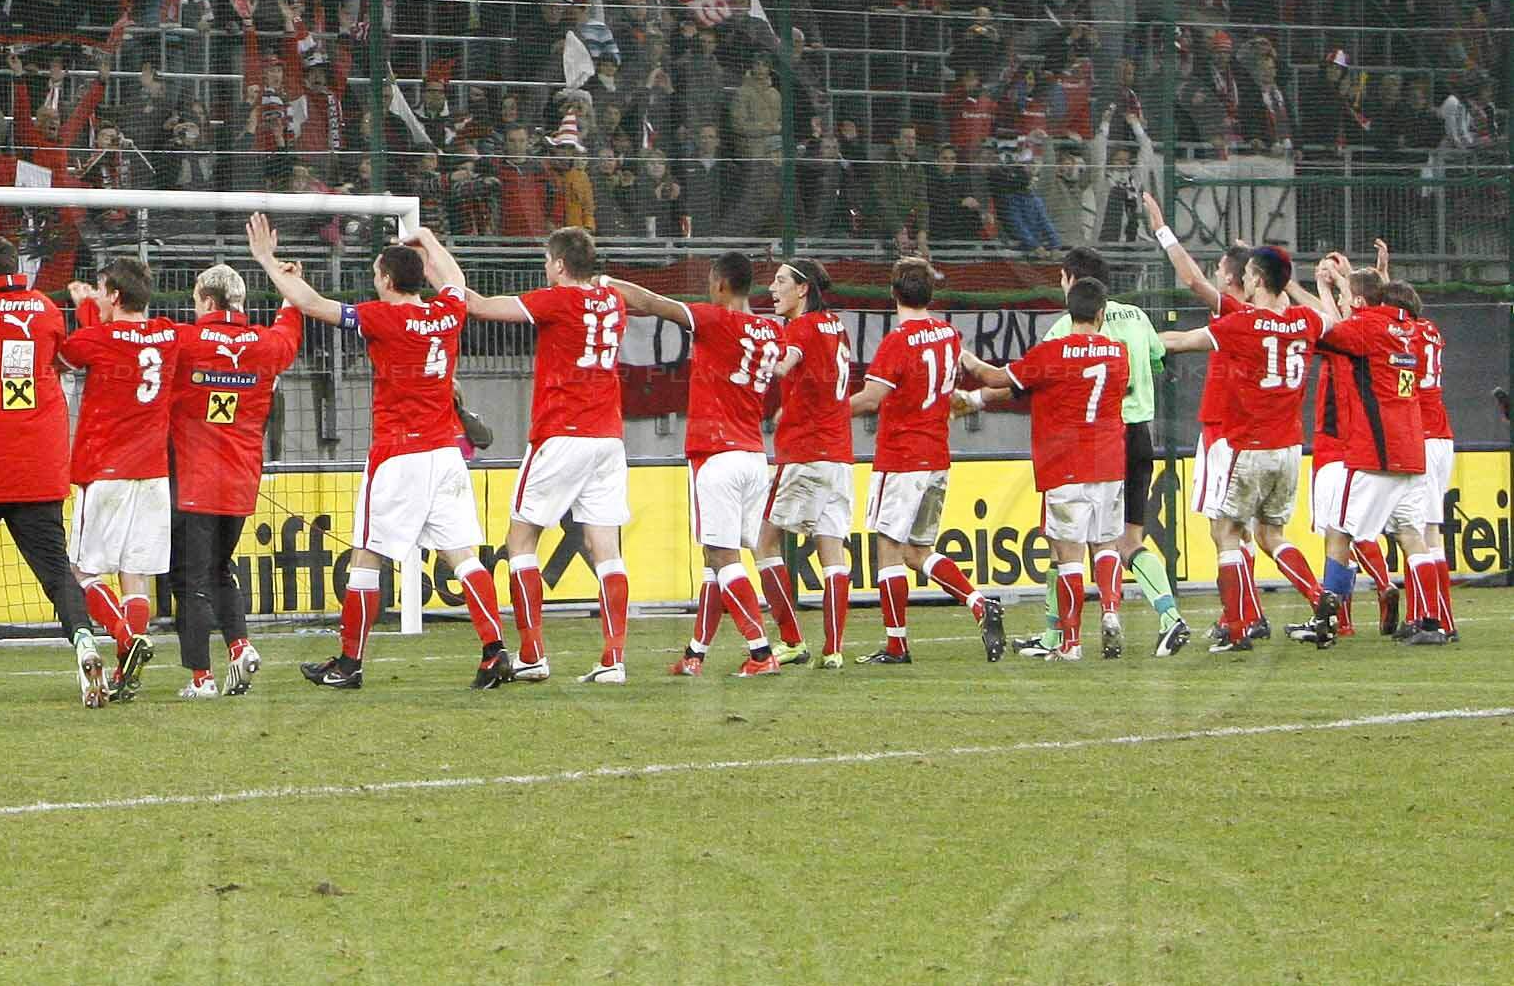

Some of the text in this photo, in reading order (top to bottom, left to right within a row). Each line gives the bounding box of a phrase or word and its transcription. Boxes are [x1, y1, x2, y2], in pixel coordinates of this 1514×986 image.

[136, 346, 163, 404] 3
[423, 336, 448, 379] 4
[1259, 335, 1309, 390] 16
[1082, 362, 1108, 424] 7
